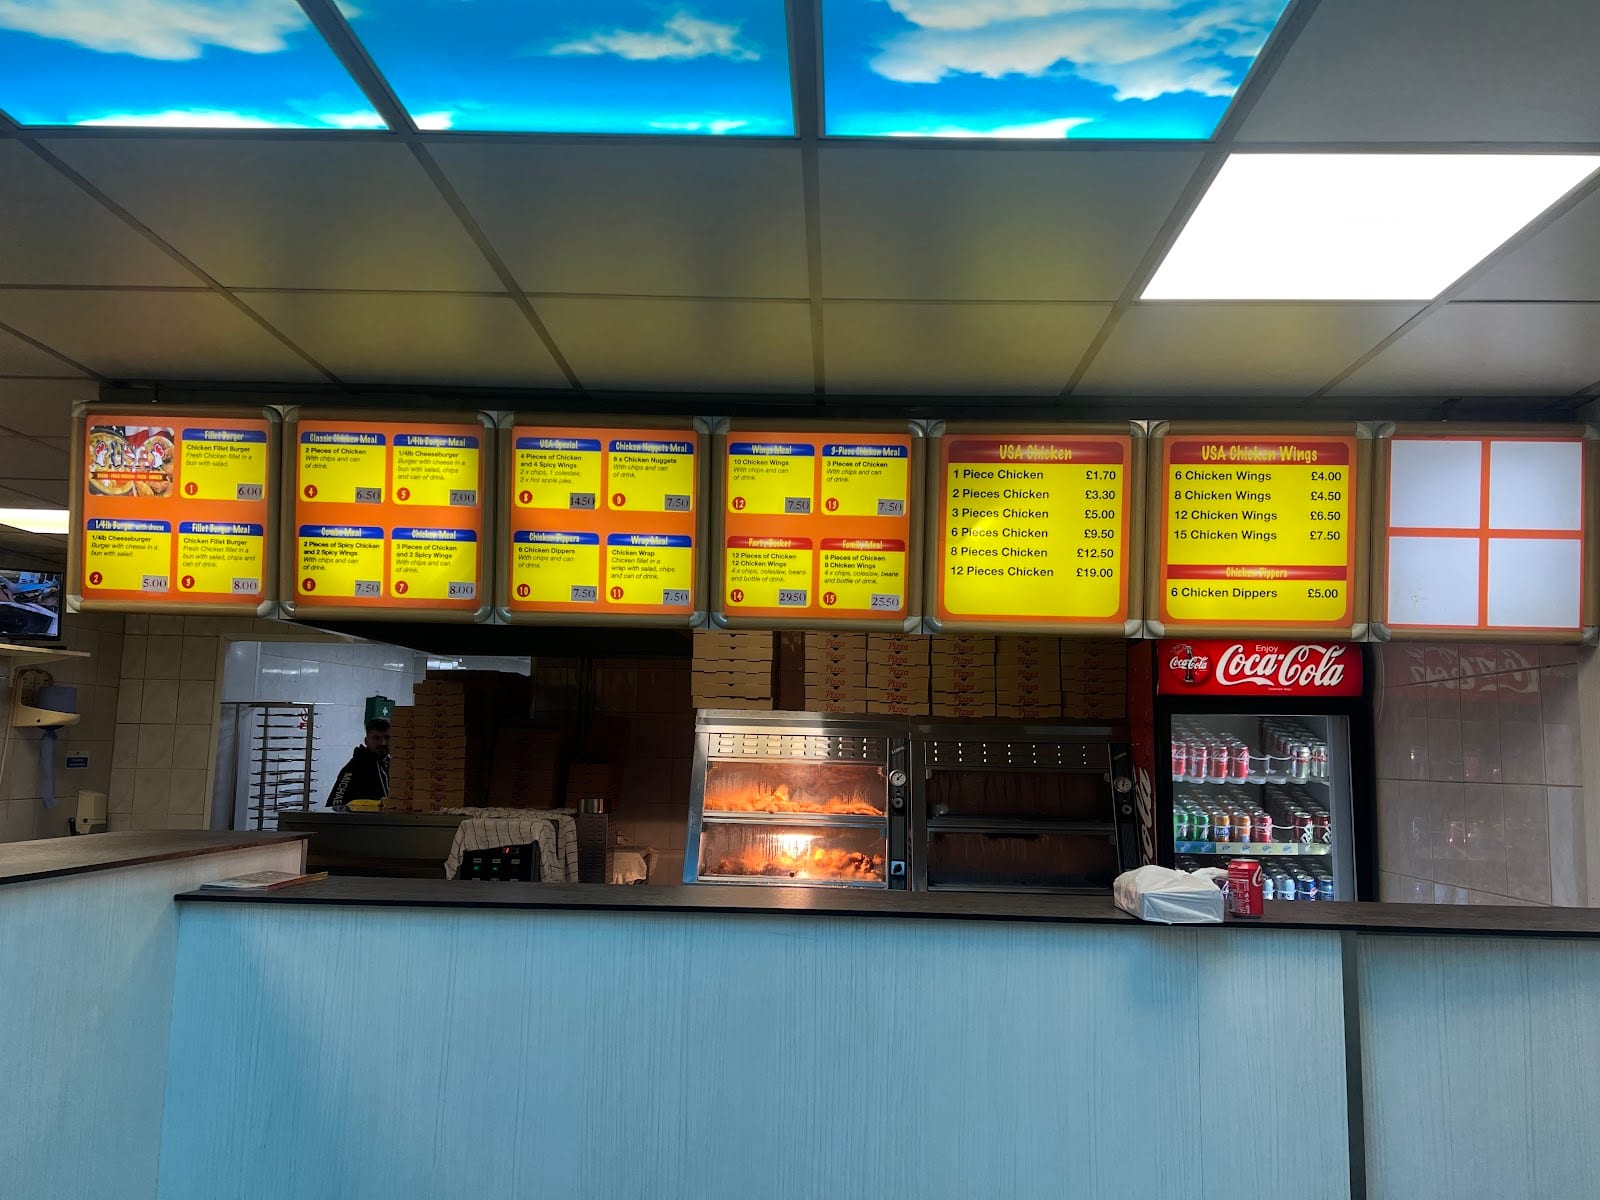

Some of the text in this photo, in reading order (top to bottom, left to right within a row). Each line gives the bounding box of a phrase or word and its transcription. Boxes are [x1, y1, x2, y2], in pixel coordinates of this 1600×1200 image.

[615, 442, 687, 453] Chicken Nuggets Meal
[999, 444, 1072, 460] USA Chicken
[1202, 446, 1318, 464] USA Chicken Wings
[954, 470, 1116, 480] 1 Piece Chicken £1.70
[1175, 471, 1341, 482] 6 Chicken Wings £4.00
[357, 490, 380, 500] 6.50
[952, 489, 1115, 500] 2 Pieces Chicken £3.30
[1174, 491, 1341, 502] 8 Chicken Wings £4.50
[788, 501, 809, 510] 7.50
[879, 502, 902, 512] 7.50
[952, 508, 1115, 519] 3 Pieces Chicken £5.00
[1175, 510, 1341, 522] 12 Chicken Wings £6.50
[192, 523, 250, 535] Fillet Burger Meal
[951, 528, 1114, 539] 6 Pieces Chicken £9.50
[1174, 530, 1340, 541] 15 Chicken Wings £7.50
[950, 547, 1114, 558] 8 Pieces Chicken £12.50
[951, 567, 1113, 578] 12 Pieces Chicken £19.00
[1225, 567, 1288, 579] Chicken Dippers
[143, 579, 167, 588] 5.00
[233, 581, 257, 590] 8.00
[356, 584, 379, 593] 7.50
[449, 586, 473, 595] 8.00
[574, 588, 595, 598] 7.50
[1171, 587, 1338, 599] 6 Chicken Dippers £5.00
[664, 592, 688, 602] 7.50
[825, 638, 846, 648] Pizza
[888, 641, 909, 650] Pizza
[1255, 644, 1279, 654] Enjoy
[952, 656, 973, 665] Pizza
[1169, 656, 1208, 671] Coca-Cola
[1215, 644, 1347, 686] Coca-Cola
[825, 664, 845, 673] Pizza
[889, 667, 909, 676] Pizza
[825, 703, 846, 712] Pizza
[887, 704, 909, 713] Pizza
[954, 707, 974, 716] Pizza
